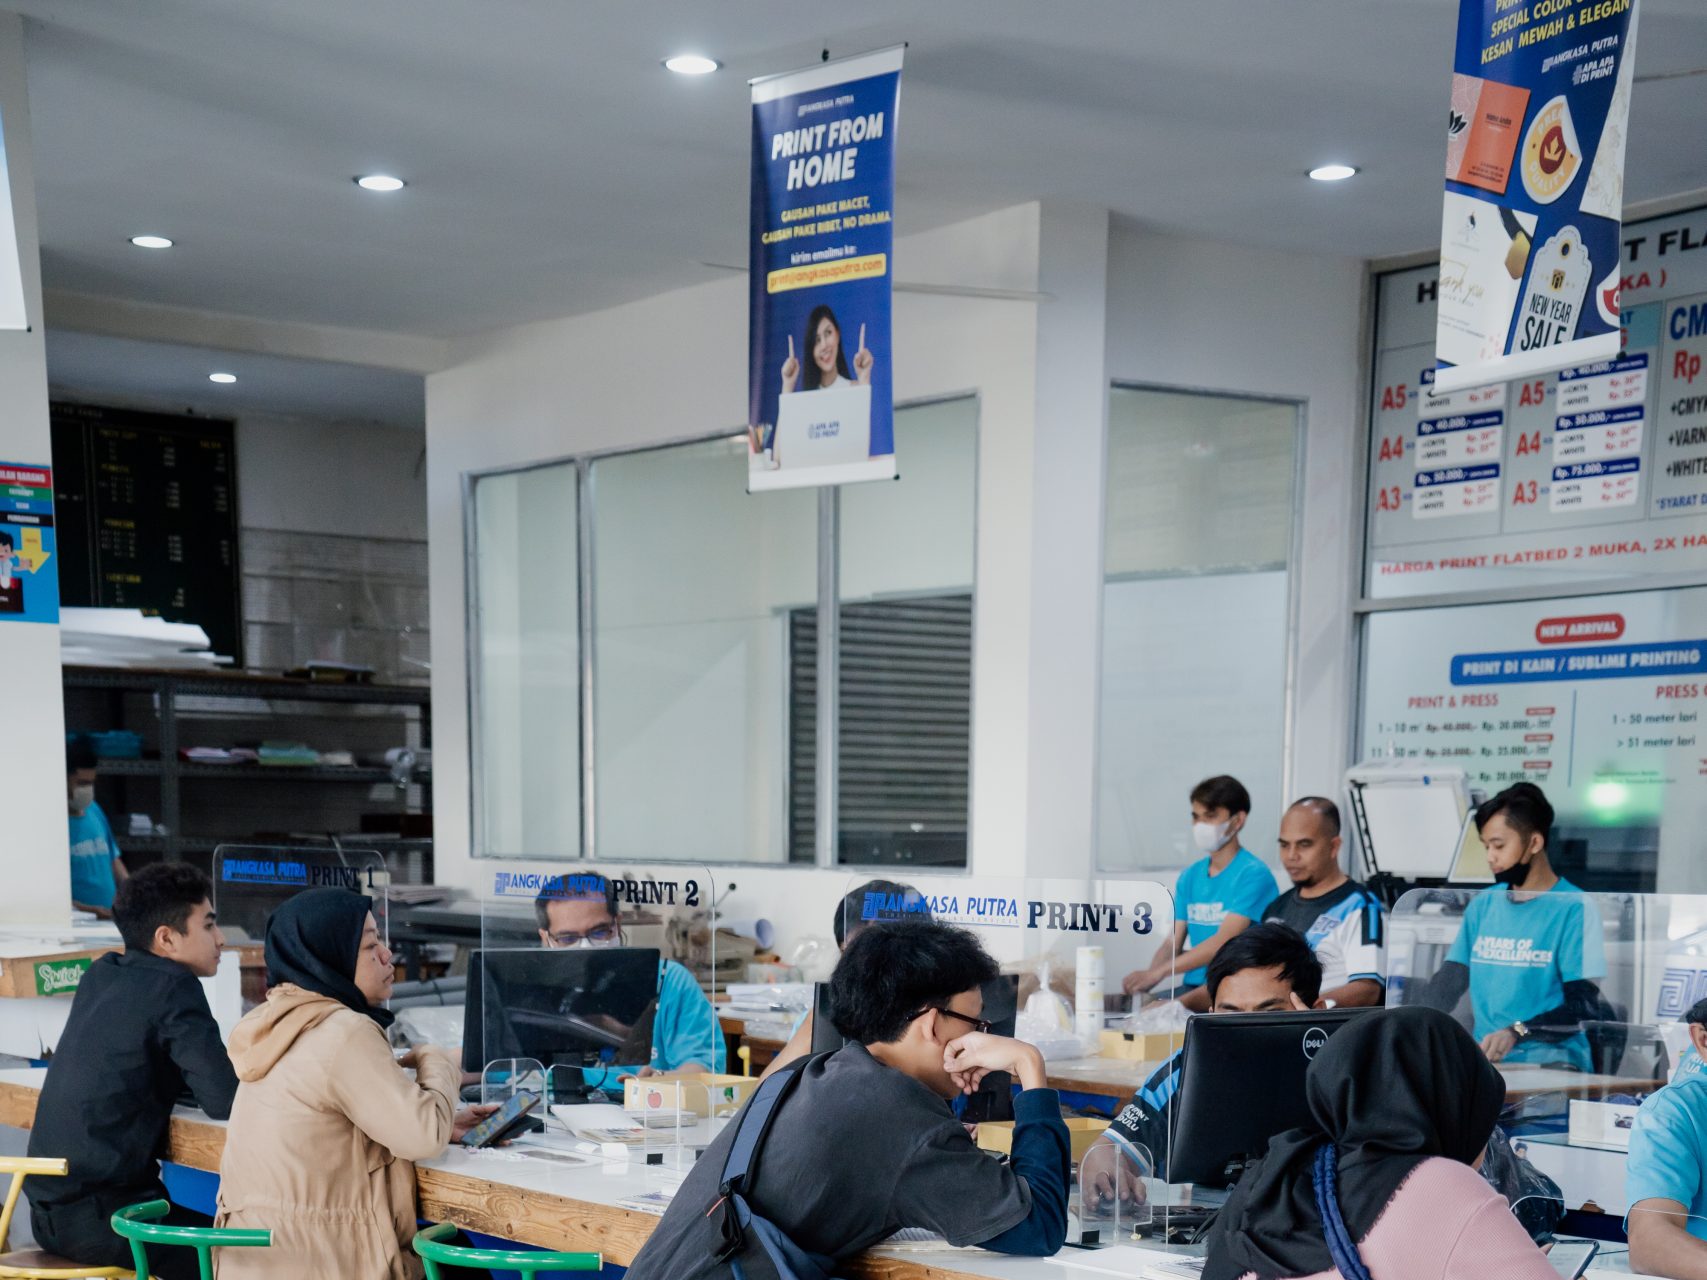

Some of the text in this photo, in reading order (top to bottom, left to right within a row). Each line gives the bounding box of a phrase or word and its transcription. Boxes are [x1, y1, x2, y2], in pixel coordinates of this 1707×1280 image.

[1491, 8, 1529, 38] SPECIAL
[1481, 37, 1513, 64] KESAN
[1518, 17, 1564, 48] MEWAH
[1566, 14, 1576, 30] &
[1553, 34, 1619, 64] ANGKASA PUTRA
[1590, 65, 1614, 80] PRINT
[1598, 55, 1614, 69] APA
[771, 112, 884, 160] PRINT FROM
[786, 147, 858, 191] HOME
[816, 202, 837, 216] PAKE
[843, 216, 857, 229] NO
[791, 251, 811, 264] kirim
[812, 247, 843, 261] emailmu
[1529, 292, 1572, 324] NEW YEAR
[1674, 350, 1701, 384] Rp
[1382, 384, 1407, 410] A5
[1519, 381, 1545, 407] A5
[1378, 435, 1404, 461] A4
[1516, 431, 1541, 456] A4
[1376, 486, 1401, 512] A3
[1513, 480, 1538, 506] A3
[1380, 560, 1435, 575] HARGA
[1439, 555, 1488, 569] PRINT
[1493, 547, 1568, 565] FLATBED
[1574, 546, 1584, 559] 2
[1589, 540, 1648, 557] MUKA,
[1653, 537, 1676, 551] 2X
[1541, 620, 1618, 638] NEW ARRIVAL
[1462, 661, 1501, 677] PRINT
[1503, 660, 1519, 674] DI
[1521, 658, 1556, 673] KAIN
[1567, 653, 1627, 671] SUBLIME
[1629, 649, 1702, 668] PRINTING
[1408, 693, 1499, 708] PRINT & PRESS
[1656, 684, 1698, 699] PRESS
[1645, 714, 1675, 723] meter
[1643, 738, 1674, 747] meter
[311, 866, 360, 887] PRINT
[367, 866, 374, 888] 1
[511, 873, 564, 891] ANGKASA
[568, 875, 605, 893] PUTRA
[612, 880, 678, 906] PRINT
[685, 880, 699, 907] 2
[885, 892, 1153, 935] ANGKASA PUTRA PRINT 3
[1517, 939, 1533, 950] OF
[1129, 1104, 1149, 1121] PRINT
